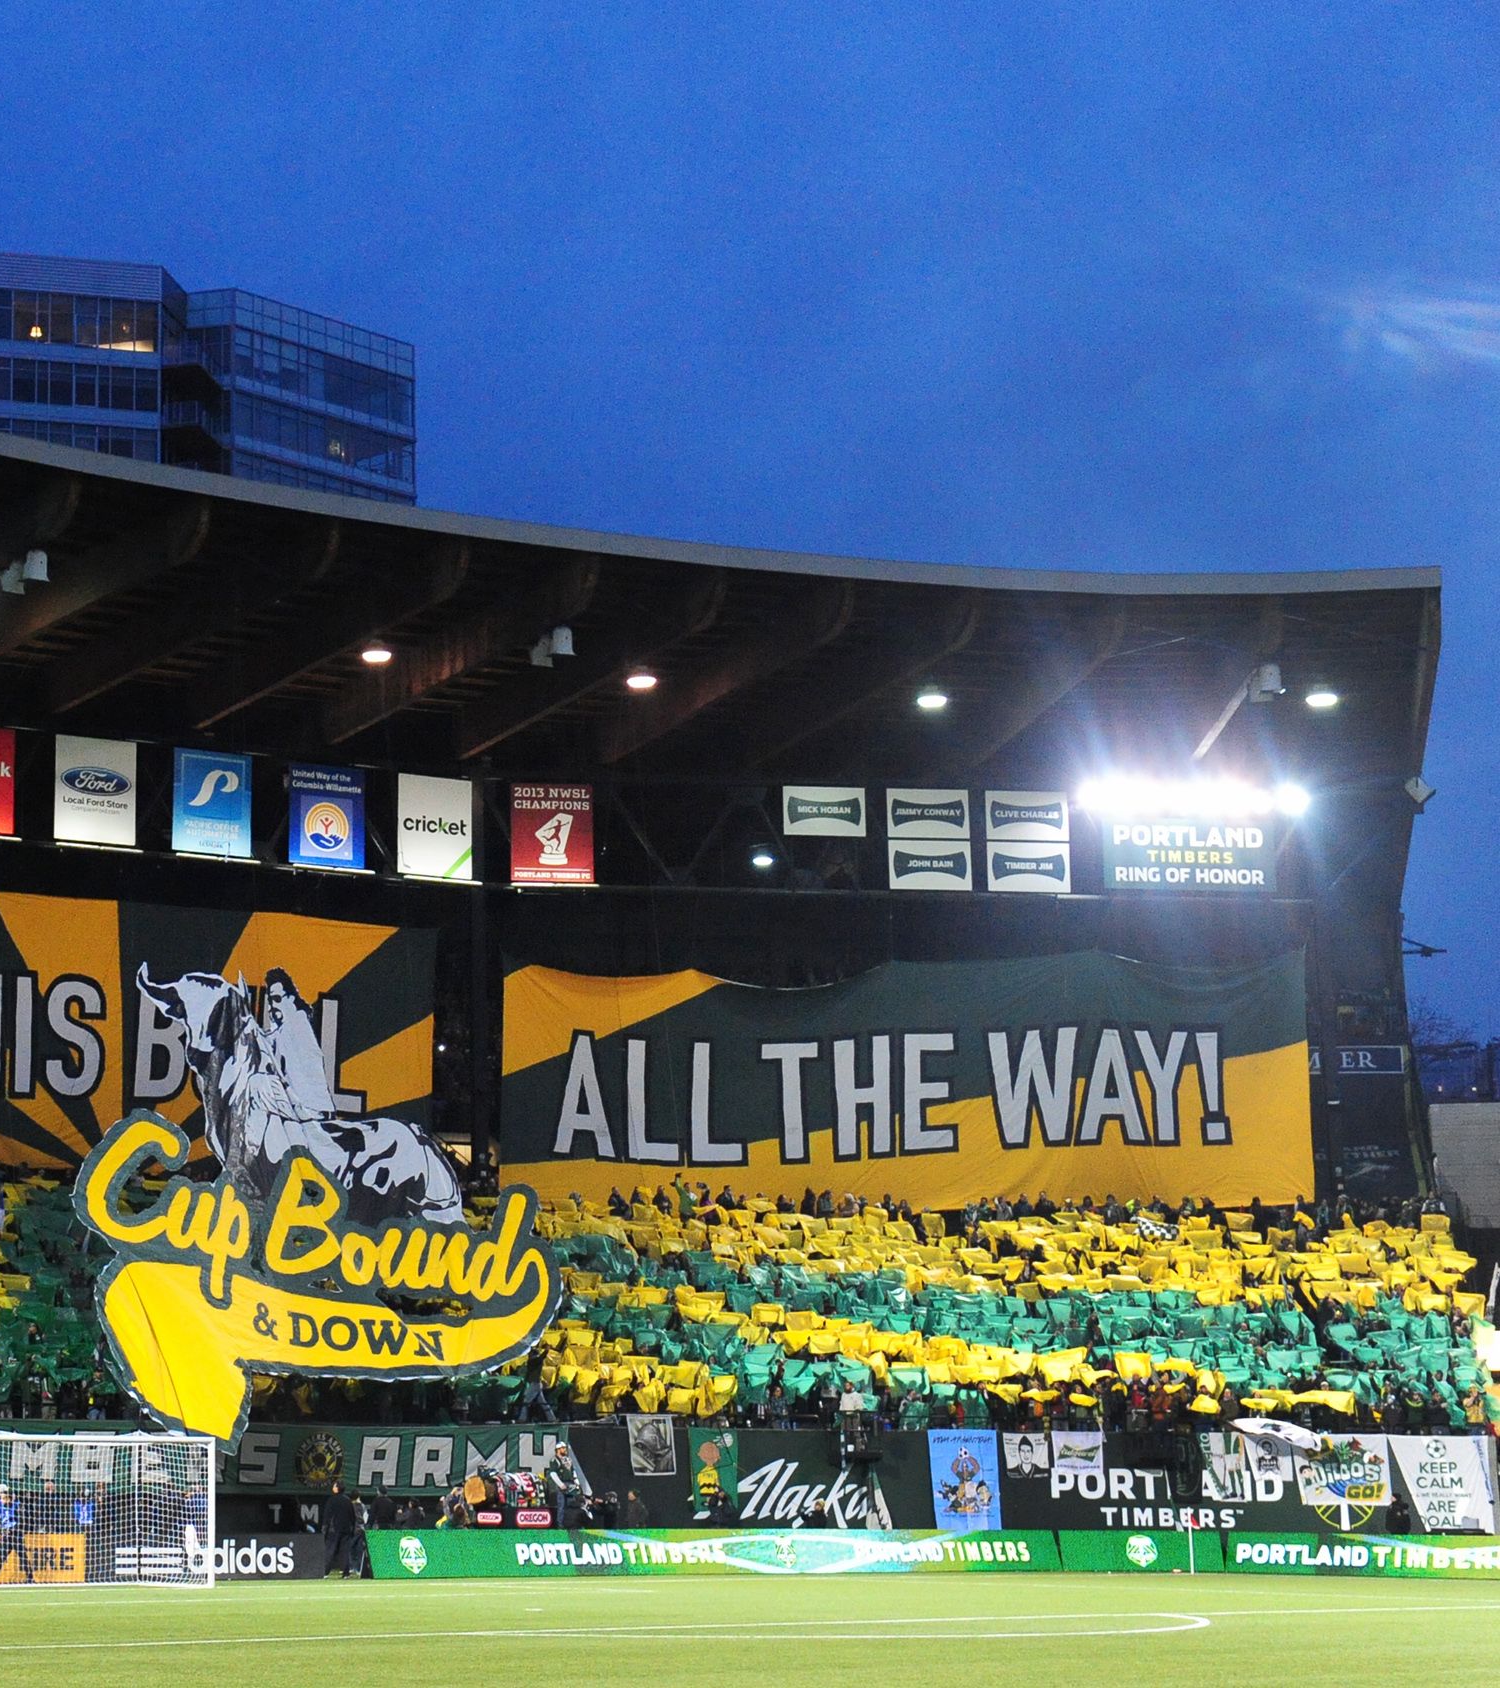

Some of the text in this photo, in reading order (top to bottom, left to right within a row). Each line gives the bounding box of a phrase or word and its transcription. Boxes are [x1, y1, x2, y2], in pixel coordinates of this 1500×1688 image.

[75, 767, 118, 792] Ford
[292, 769, 352, 783] United Way of the
[514, 787, 590, 799] 2013 NWSL
[63, 796, 129, 810] Local Ford Store
[514, 800, 590, 811] CHAMPIONS
[797, 805, 851, 815] MICK HOBAN
[894, 807, 962, 817] JIMMY CONWAY
[995, 809, 1060, 820] CLIVE CHARLES
[402, 814, 467, 836] cricket
[1112, 824, 1264, 849] PORTLAND
[906, 859, 932, 868] JOHN
[1004, 861, 1054, 871] TIMBER JIM
[1146, 850, 1234, 864] TIMBERS
[1114, 866, 1265, 885] RING OF HONOR
[132, 985, 366, 1115] BL
[550, 1023, 1231, 1164] ALL THE WAY!
[86, 1121, 547, 1302] Cup Bound
[252, 1303, 445, 1361] & DOWN
[358, 1433, 561, 1487] ARMY
[1419, 1462, 1457, 1474] KEEP
[1051, 1468, 1284, 1502] PORTAD
[1416, 1477, 1463, 1489] CALM
[1426, 1501, 1456, 1512] ARE
[519, 1513, 549, 1523] OREGON
[1100, 1507, 1236, 1529] TIMBERS
[25, 1548, 75, 1570] IRE
[516, 1542, 728, 1566] PORTLAND TIMBERS
[942, 1541, 1031, 1563] TIMBERS
[1235, 1542, 1500, 1569] PORTLAND TIMBER
